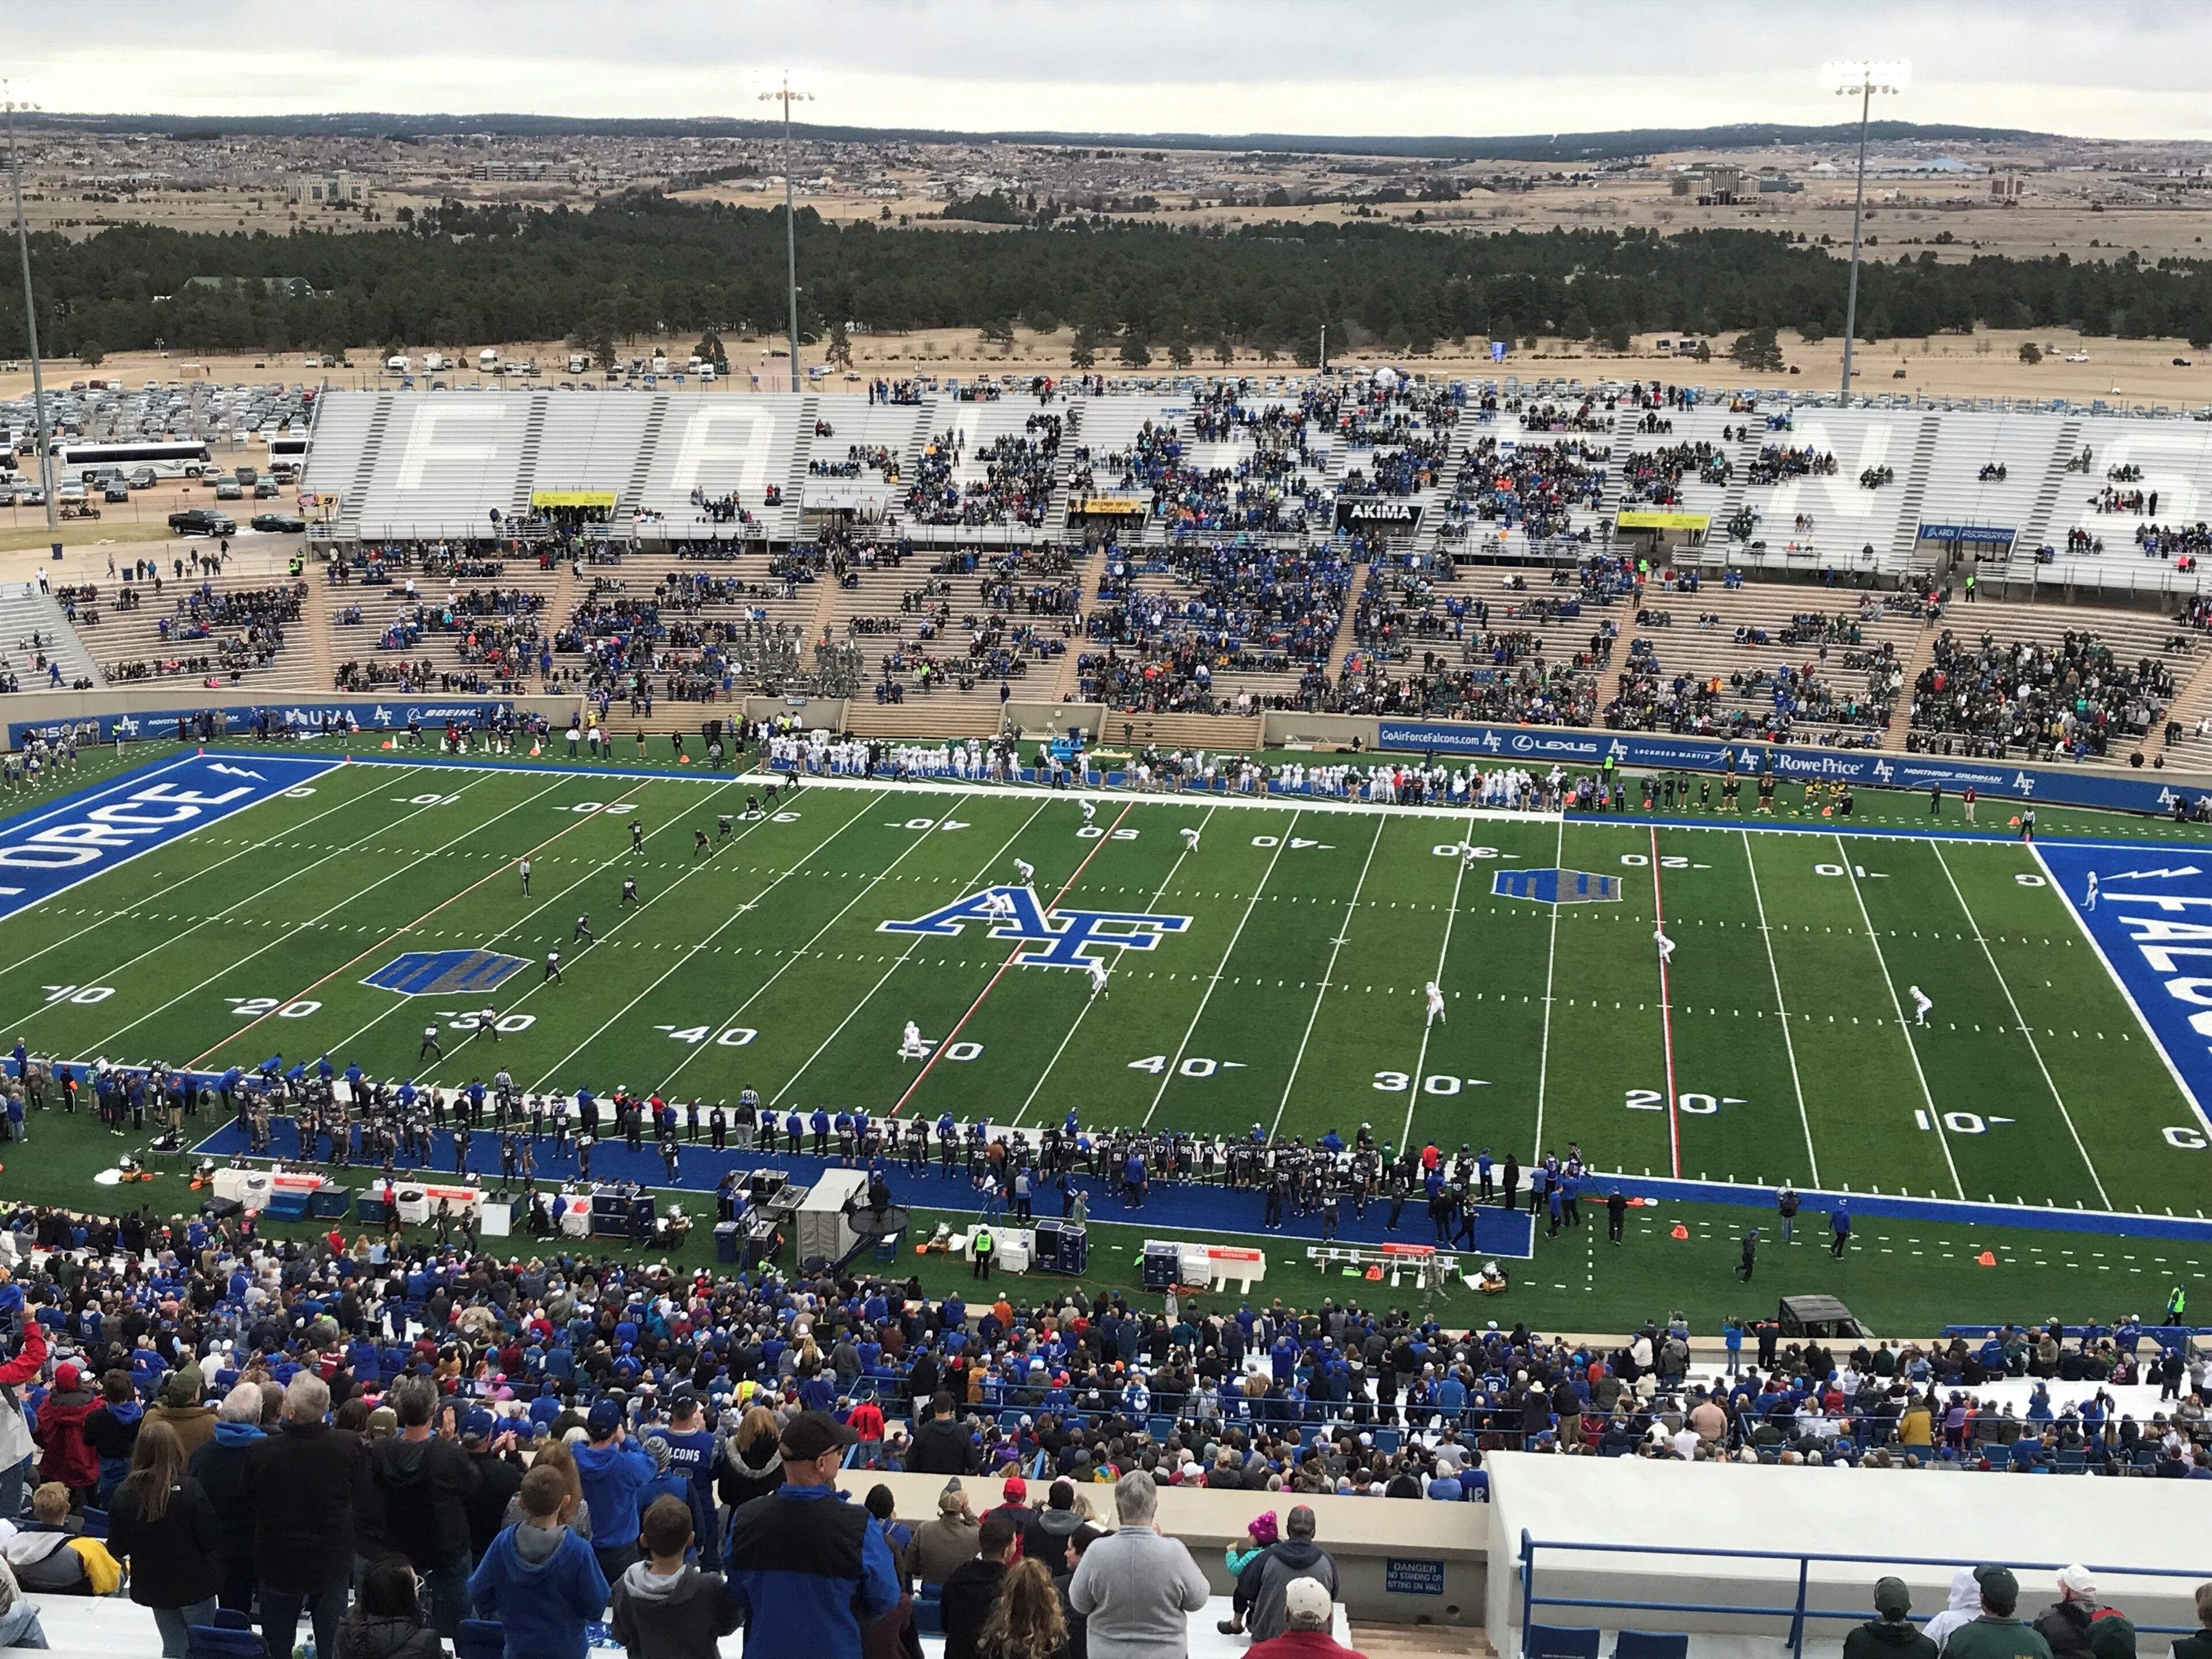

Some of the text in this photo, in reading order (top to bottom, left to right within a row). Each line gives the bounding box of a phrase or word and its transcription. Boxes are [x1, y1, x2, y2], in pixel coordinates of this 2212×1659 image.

[1350, 505, 1412, 519] AKIMA
[374, 705, 392, 725] AF
[1382, 730, 1479, 745] GoAirForceFalcons.com
[1482, 730, 1501, 752] AF
[1535, 740, 1597, 752] LEXUS
[1608, 738, 1628, 760] AF
[1635, 749, 1711, 760] LOCKHEED MARTIN
[1738, 748, 1759, 770] AF
[1779, 754, 1820, 772] Rowe
[1822, 757, 1861, 775] Price
[1873, 759, 1894, 782] AF
[1903, 768, 2003, 782] NORTHROP GRUMMAN
[2013, 771, 2035, 796] AF
[409, 793, 461, 806] 10
[570, 802, 639, 815] 20
[904, 818, 971, 831] 40
[0, 783, 255, 895] ORCE
[1075, 827, 1141, 840] 50
[1251, 835, 1320, 849] 40
[1620, 853, 1689, 869] 20
[1814, 862, 1866, 879] 10
[875, 885, 1195, 969] AF
[44, 984, 116, 1004] 10
[231, 997, 323, 1019] 20
[448, 1011, 537, 1033] 30
[667, 1025, 759, 1047] 40
[1127, 1055, 1218, 1079] 40
[1373, 1071, 1462, 1096] 30
[1624, 1089, 1719, 1115] 20
[1914, 1108, 1987, 1134] 10
[332, 1126, 344, 1135] 75
[2161, 1127, 2208, 1149] G
[665, 1143, 673, 1152] 2
[230, 1160, 241, 1169] 77
[561, 1184, 574, 1193] 24
[1677, 1228, 1685, 1237] 20
[632, 1313, 643, 1324] 18
[80, 1323, 93, 1335] 18
[1488, 1381, 1498, 1392] 18
[1393, 1562, 1437, 1573] DANGER
[1400, 1572, 1430, 1581] STANDING
[1388, 1581, 1411, 1589] SITTING
[1425, 1584, 1442, 1592] WALL
